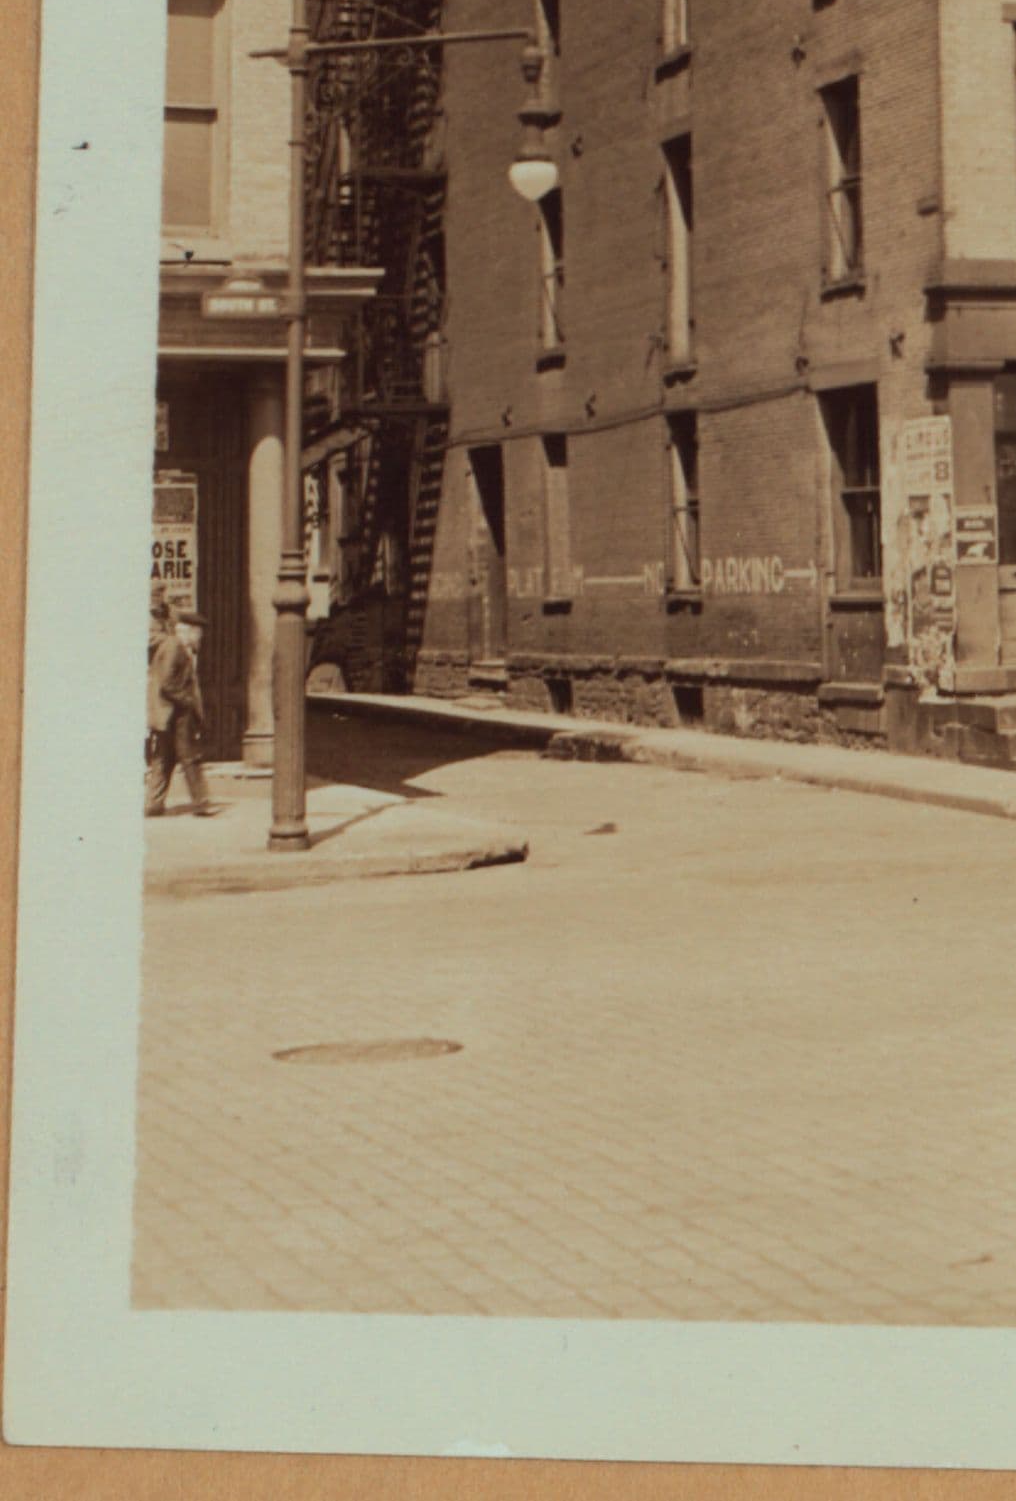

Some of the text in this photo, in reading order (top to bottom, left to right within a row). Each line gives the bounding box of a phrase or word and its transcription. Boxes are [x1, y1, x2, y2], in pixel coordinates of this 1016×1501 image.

[152, 540, 187, 559] OSE
[151, 560, 192, 580] ARIE
[702, 555, 785, 595] PARKING
